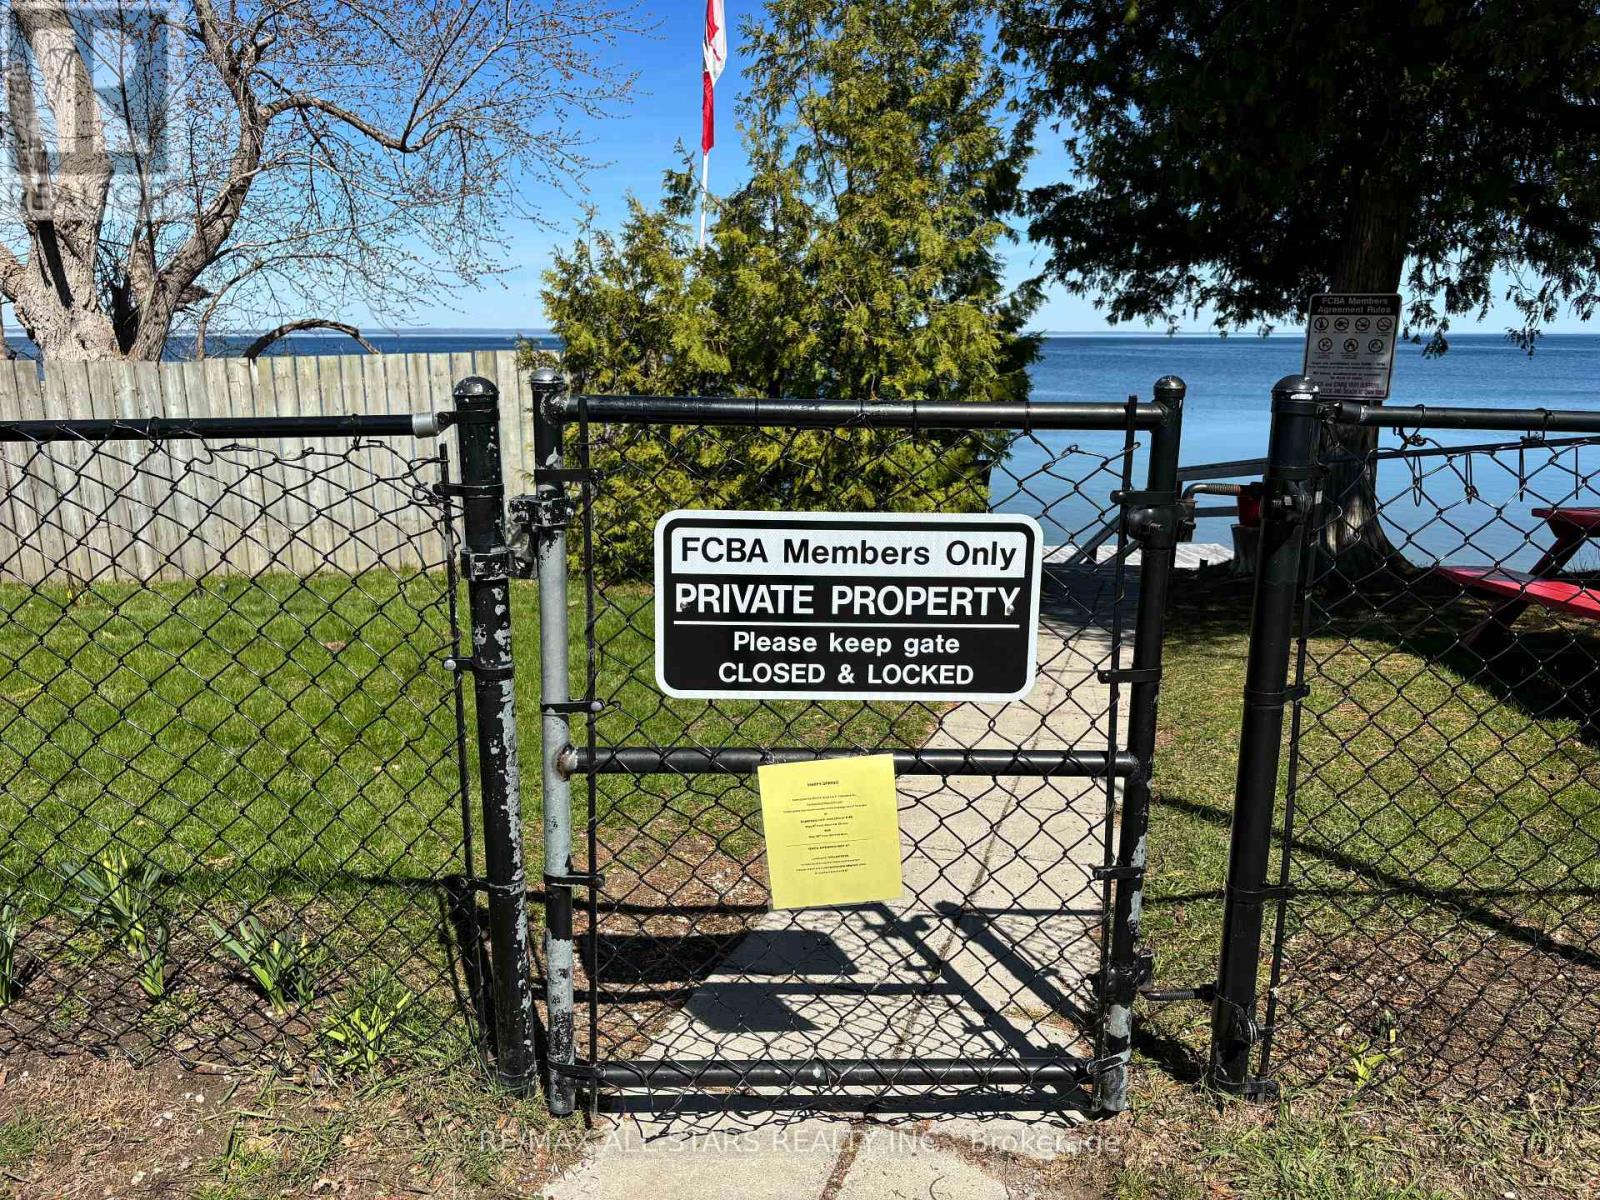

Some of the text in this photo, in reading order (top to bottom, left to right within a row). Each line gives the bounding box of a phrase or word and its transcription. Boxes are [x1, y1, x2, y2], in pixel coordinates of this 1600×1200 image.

[1318, 306, 1364, 314] Agreement
[1322, 297, 1388, 305] FCBA Members
[681, 536, 1016, 570] FCBA Members Only
[675, 582, 1020, 616] PRIVATE PROPERTY
[734, 631, 960, 658] Please keep gate
[718, 662, 974, 685] CLOSED & LOCKED
